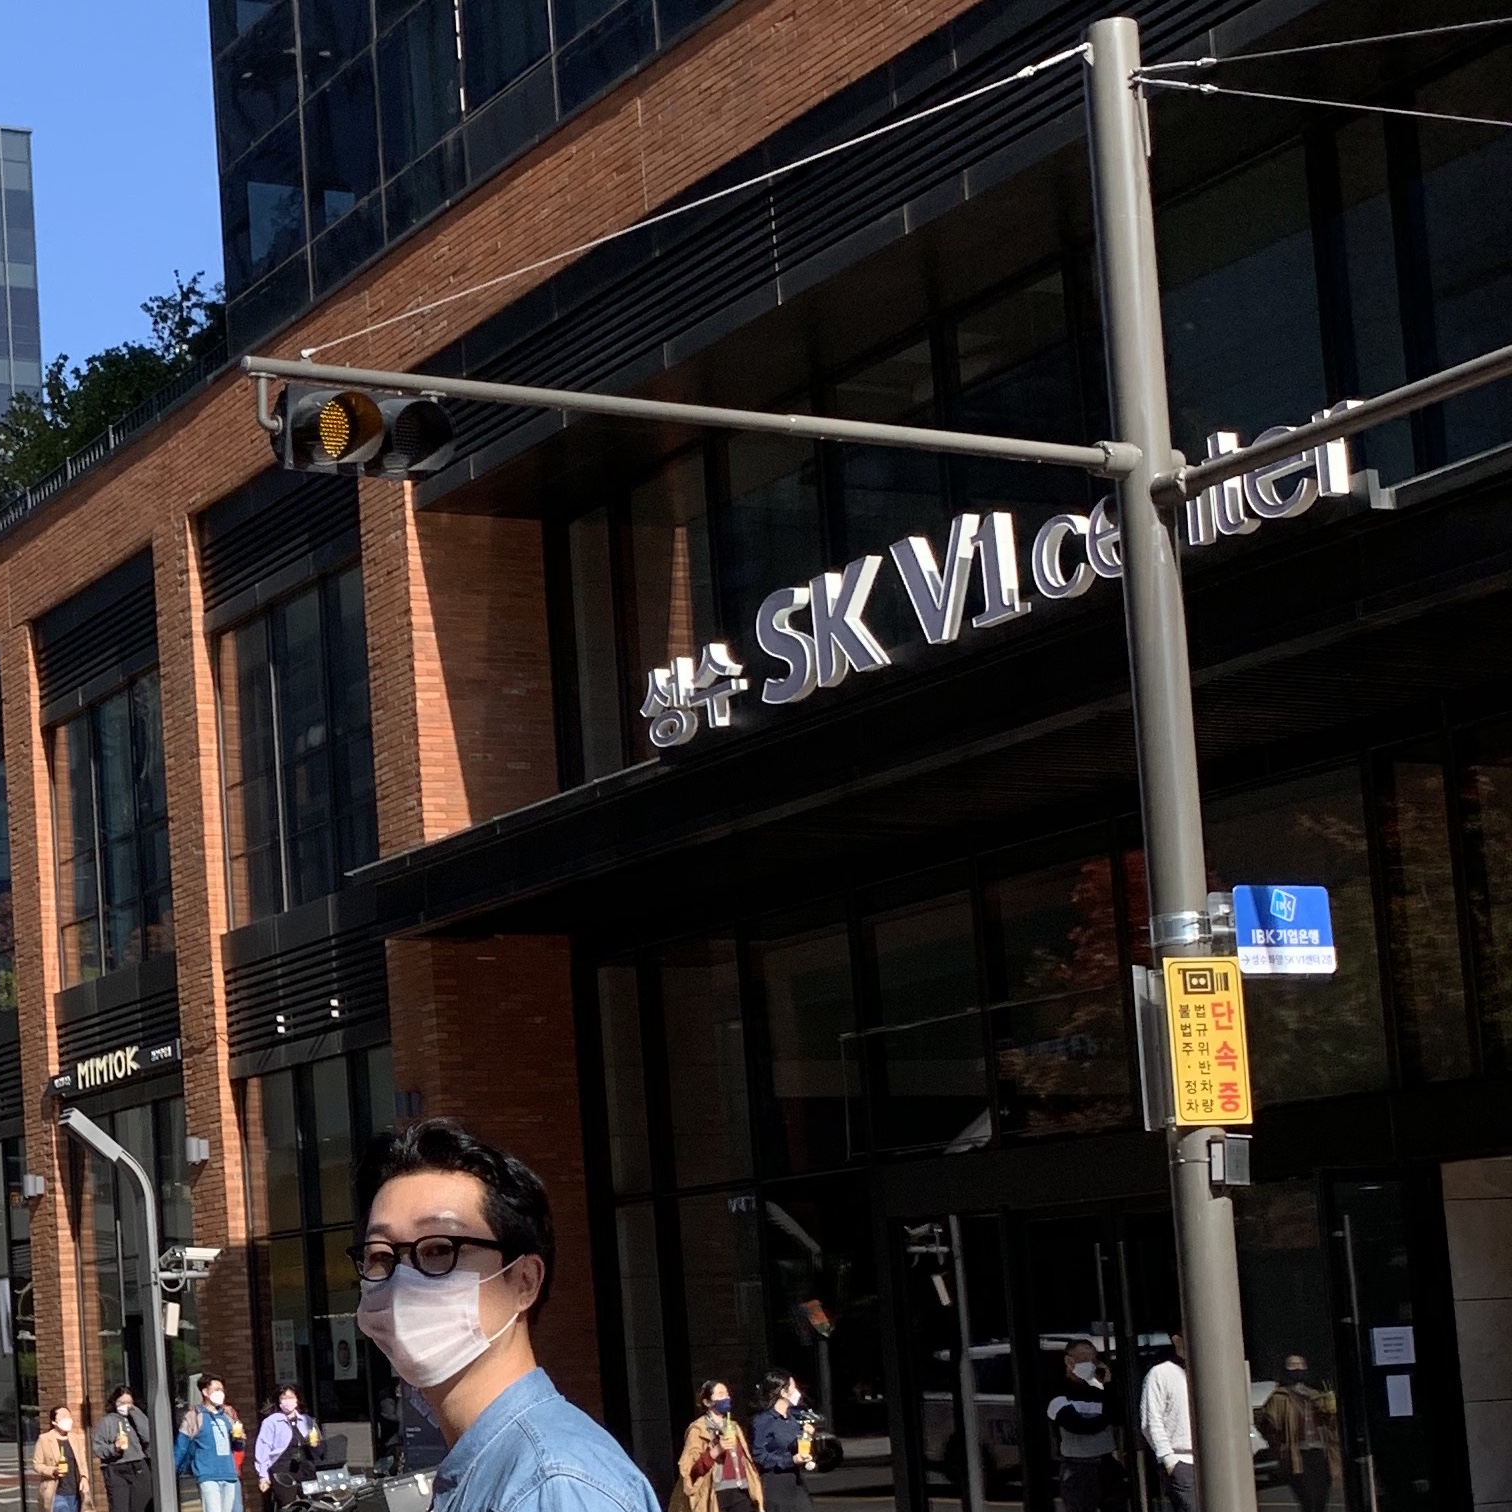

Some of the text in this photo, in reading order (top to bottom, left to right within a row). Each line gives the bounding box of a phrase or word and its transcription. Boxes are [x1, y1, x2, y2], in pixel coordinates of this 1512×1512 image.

[640, 400, 1364, 748] 성수 SK V1 ceter
[76, 1045, 142, 1090] MIMIOK
[1211, 1000, 1241, 1113] 단속중
